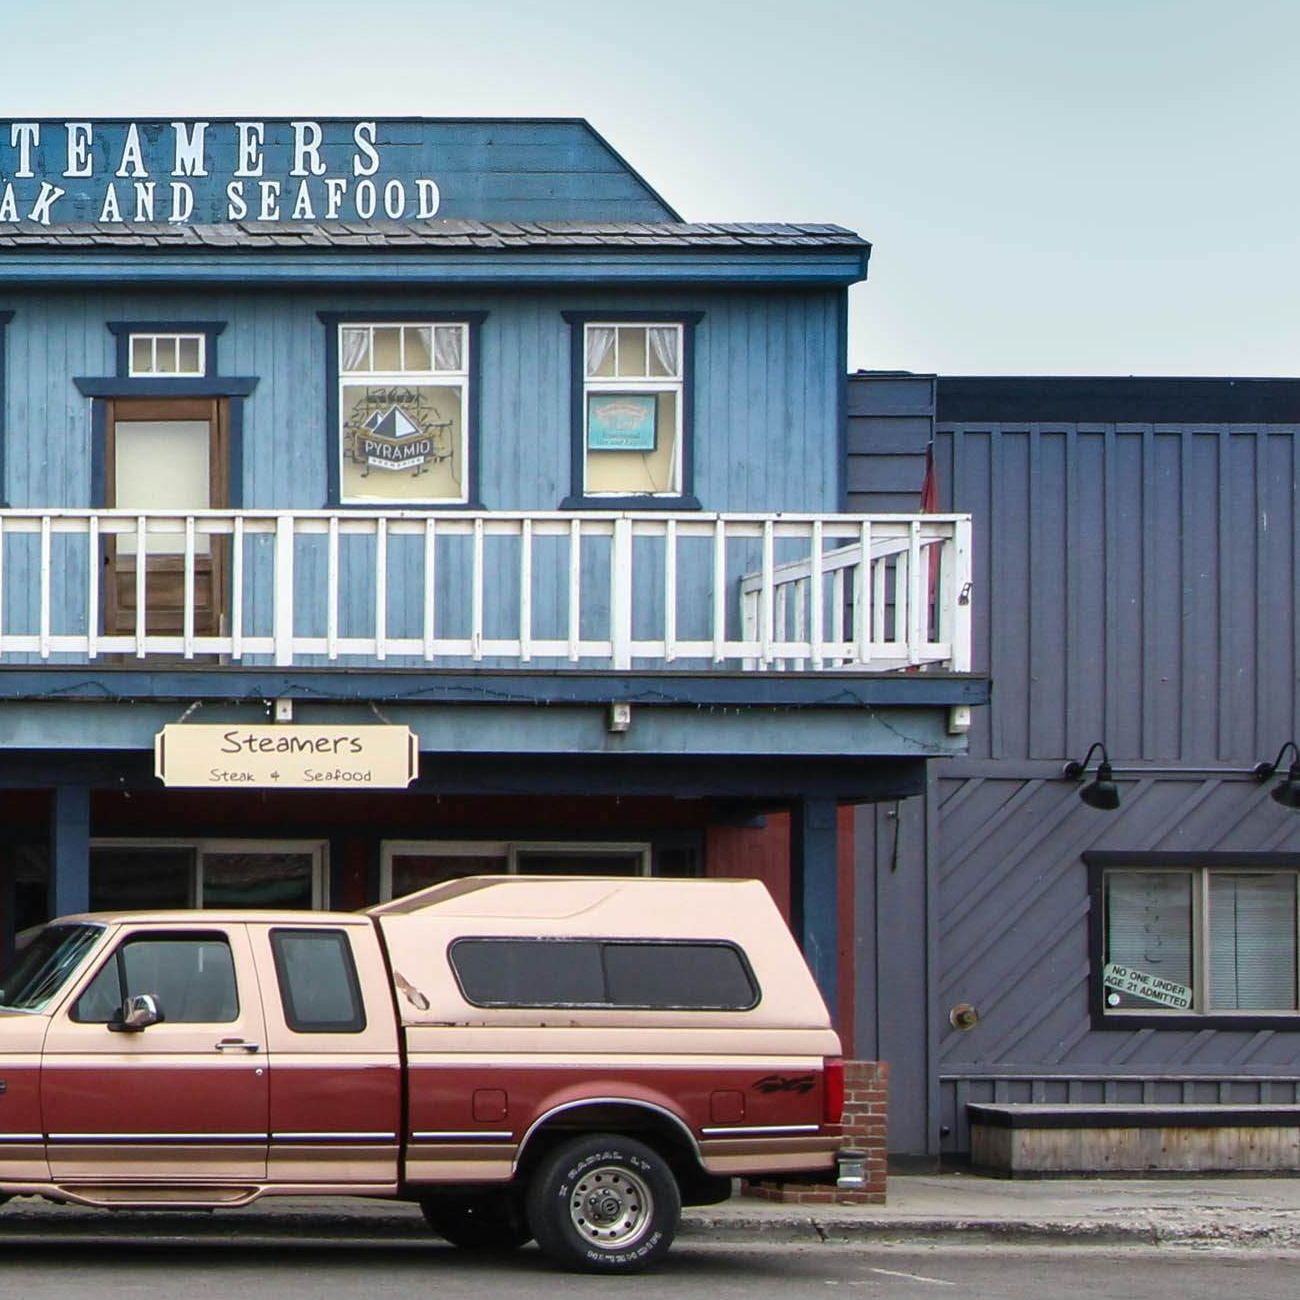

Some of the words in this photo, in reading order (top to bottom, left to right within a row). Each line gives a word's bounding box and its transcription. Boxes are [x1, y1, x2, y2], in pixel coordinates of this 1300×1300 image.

[99, 180, 194, 223] AND
[228, 179, 441, 222] SEAFOOD
[365, 440, 430, 459] PYRAMID
[221, 731, 362, 754] Steamers
[210, 769, 255, 782] Steak
[304, 769, 372, 782] Seafood
[1105, 975, 1125, 988] AGE
[1127, 982, 1138, 993] 21
[1140, 987, 1188, 1008] ADMITTED
[1112, 965, 1127, 977] NO
[1129, 971, 1151, 985] ONE
[1152, 979, 1185, 996] UNDER
